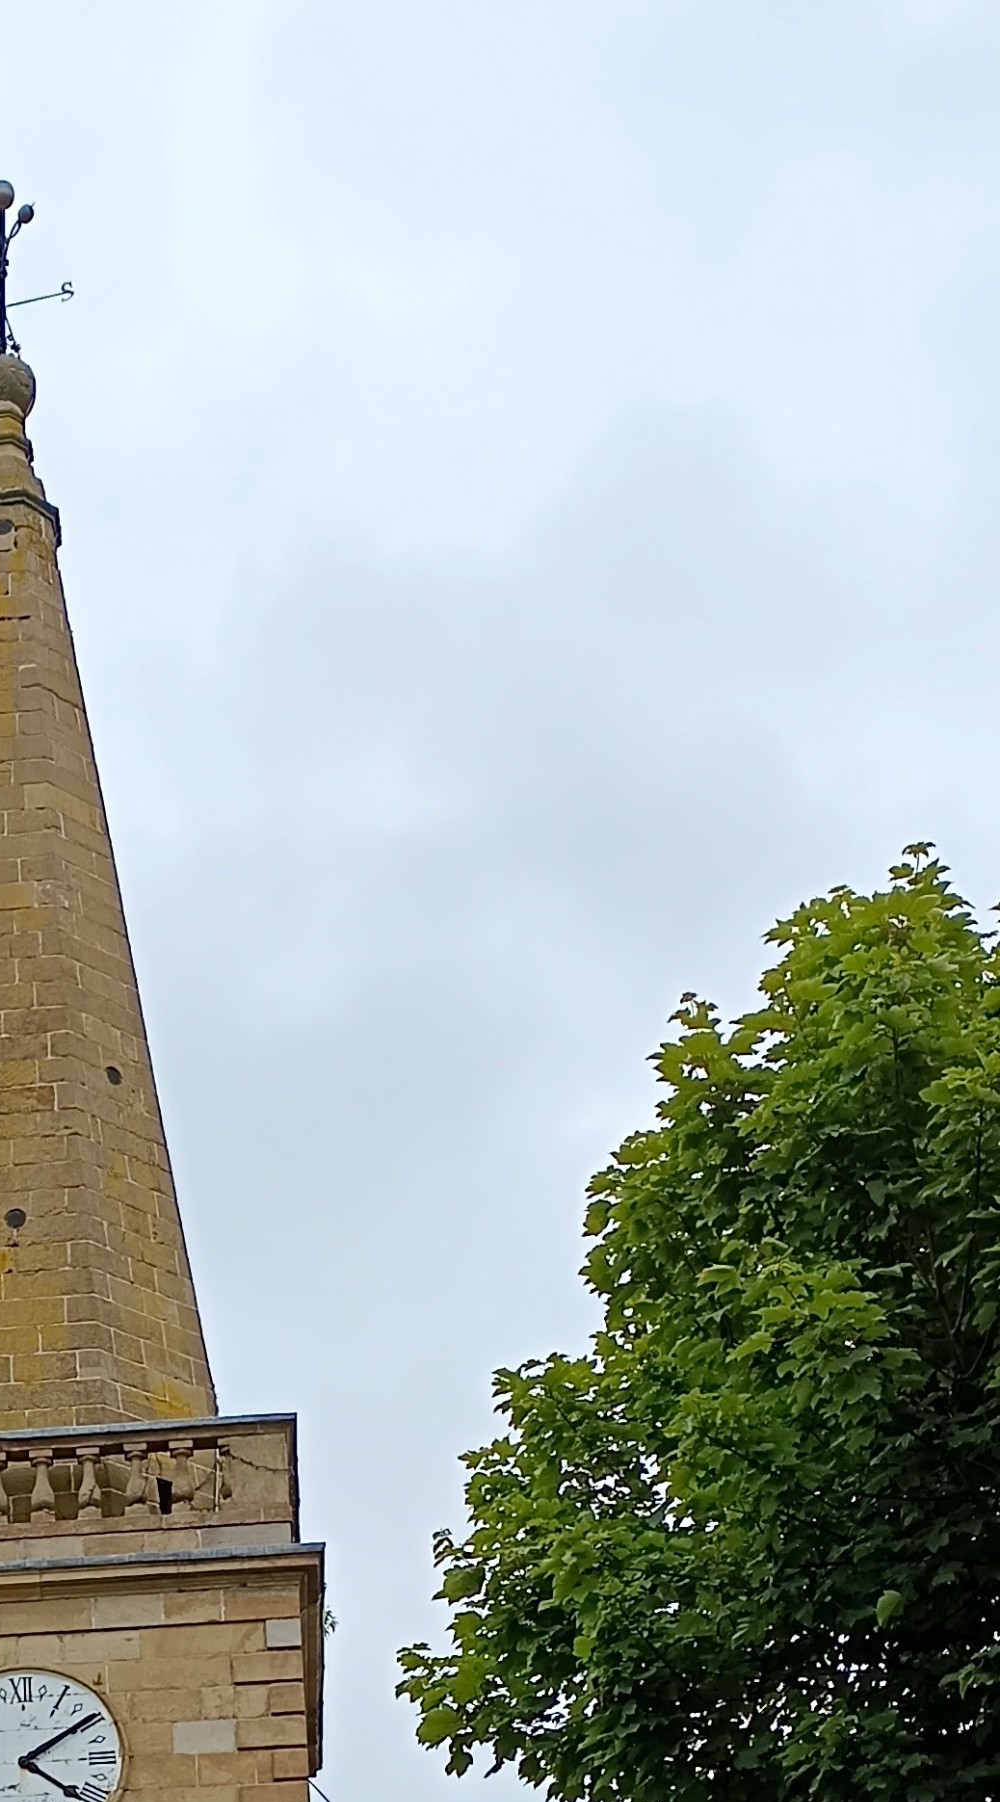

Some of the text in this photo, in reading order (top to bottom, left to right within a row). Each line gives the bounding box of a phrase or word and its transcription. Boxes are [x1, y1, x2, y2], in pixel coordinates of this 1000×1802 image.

[60, 281, 74, 302] S
[8, 1676, 33, 1705] XII
[51, 1684, 71, 1711] I
[88, 1750, 117, 1766] III
